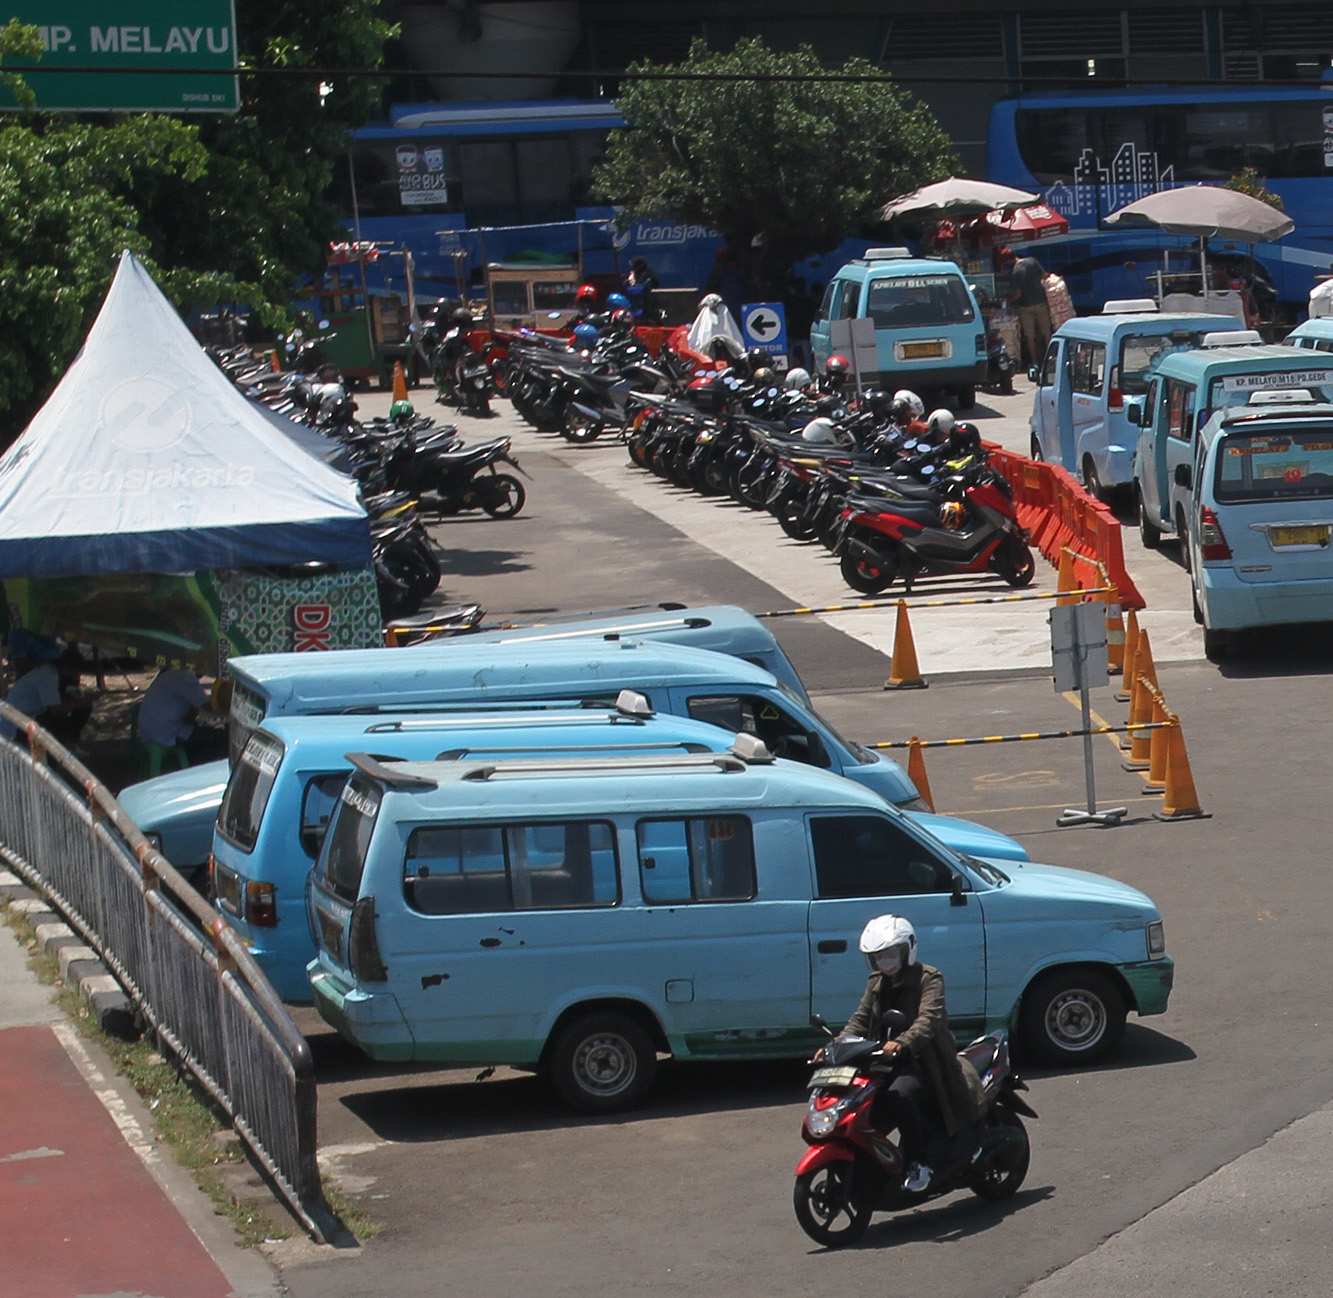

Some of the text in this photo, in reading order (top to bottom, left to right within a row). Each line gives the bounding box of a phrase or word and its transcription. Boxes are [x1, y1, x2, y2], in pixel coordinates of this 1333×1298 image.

[90, 26, 230, 53] MELAYU
[423, 173, 446, 189] BUS
[1248, 377, 1278, 385] MELAYU
[1278, 375, 1295, 384] M18
[1296, 372, 1327, 382] PD.GEDE
